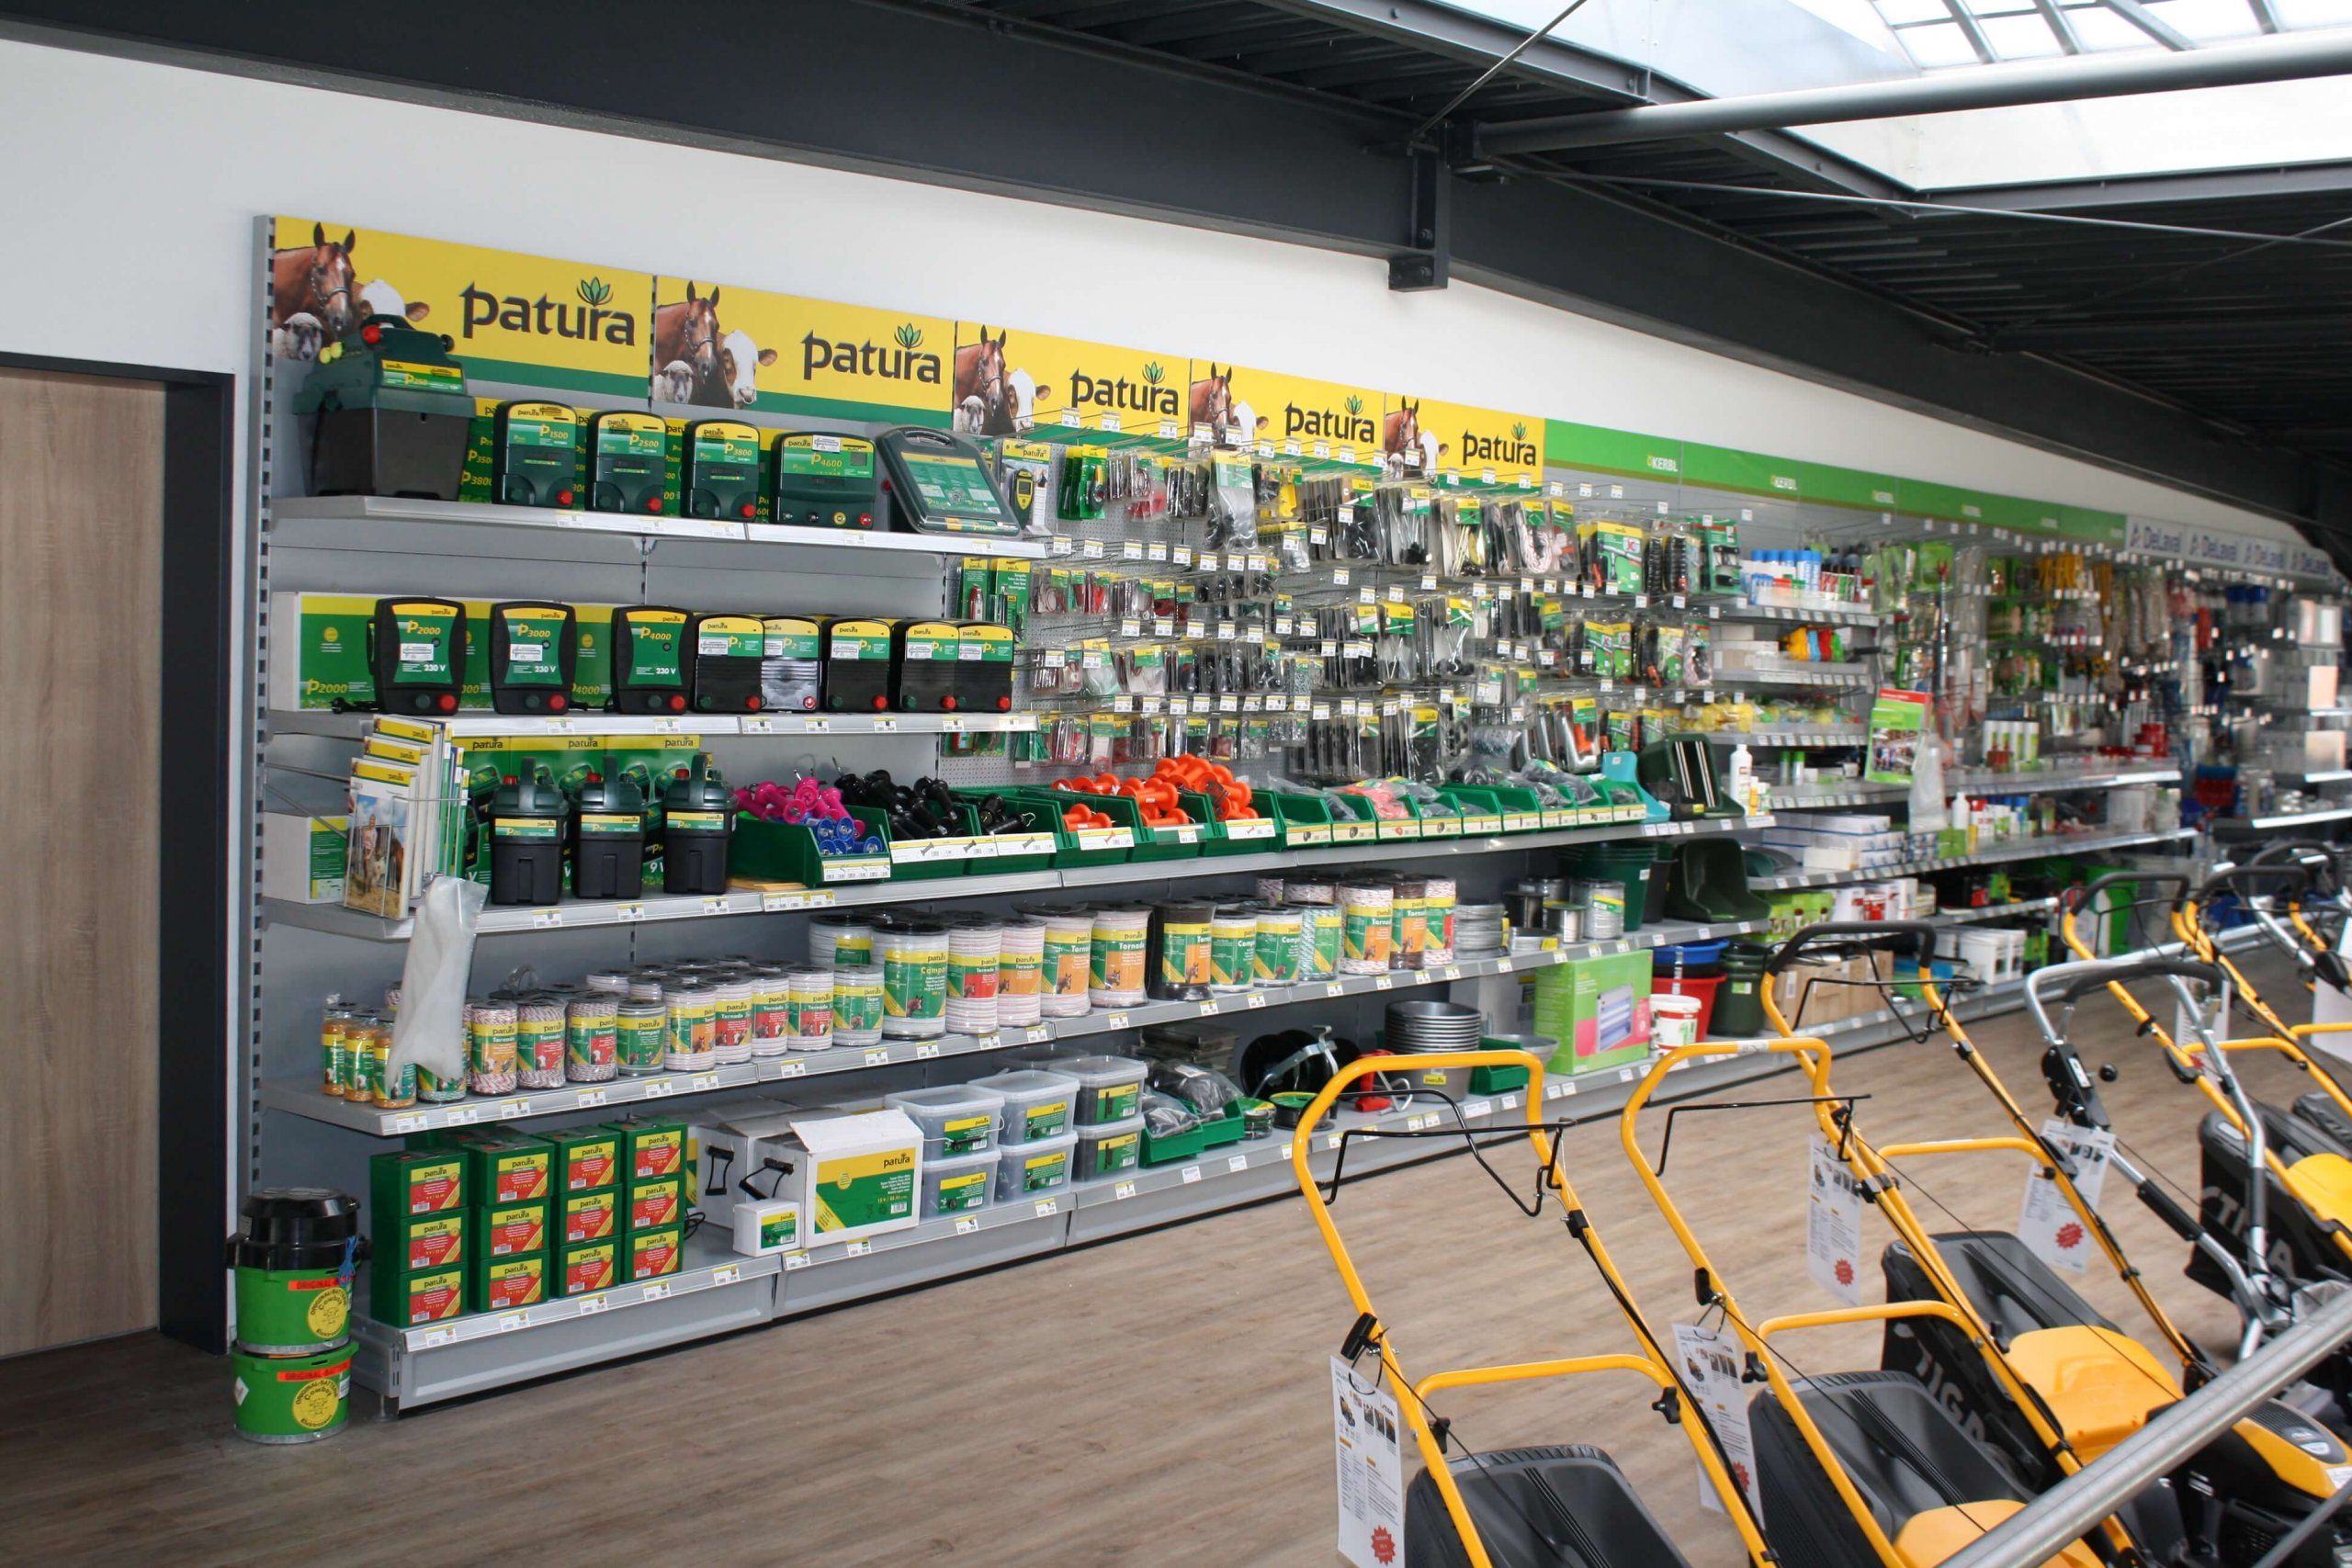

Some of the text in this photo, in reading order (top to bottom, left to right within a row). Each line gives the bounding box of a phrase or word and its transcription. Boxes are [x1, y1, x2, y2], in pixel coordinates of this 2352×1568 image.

[458, 281, 636, 346] patura
[802, 330, 941, 384] patura
[1070, 368, 1180, 416] patura
[1284, 401, 1375, 444] patura
[628, 434, 660, 447] P2500
[724, 443, 752, 457] P3800
[1462, 430, 1537, 467] patura
[811, 452, 842, 468] P4600
[1652, 457, 1678, 472] KERBL
[2143, 525, 2181, 552] DeLaval
[407, 620, 441, 636] P2000
[517, 624, 550, 637] P3000
[640, 626, 672, 640] P4000
[307, 679, 347, 695] P2000
[472, 739, 503, 750] patura
[569, 738, 597, 749] patura
[665, 738, 694, 749] patura
[649, 1135, 669, 1145] patura
[582, 1147, 603, 1156] patura
[512, 1158, 535, 1168] patura
[883, 1155, 910, 1168] patura
[424, 1168, 447, 1179] patura
[646, 1185, 666, 1194] patura
[580, 1198, 602, 1207] patura
[506, 1212, 530, 1221] patura
[424, 1224, 447, 1233] patura
[647, 1235, 667, 1246] patura
[580, 1250, 602, 1260] patura
[504, 1265, 528, 1274] patura
[424, 1278, 447, 1287] patura
